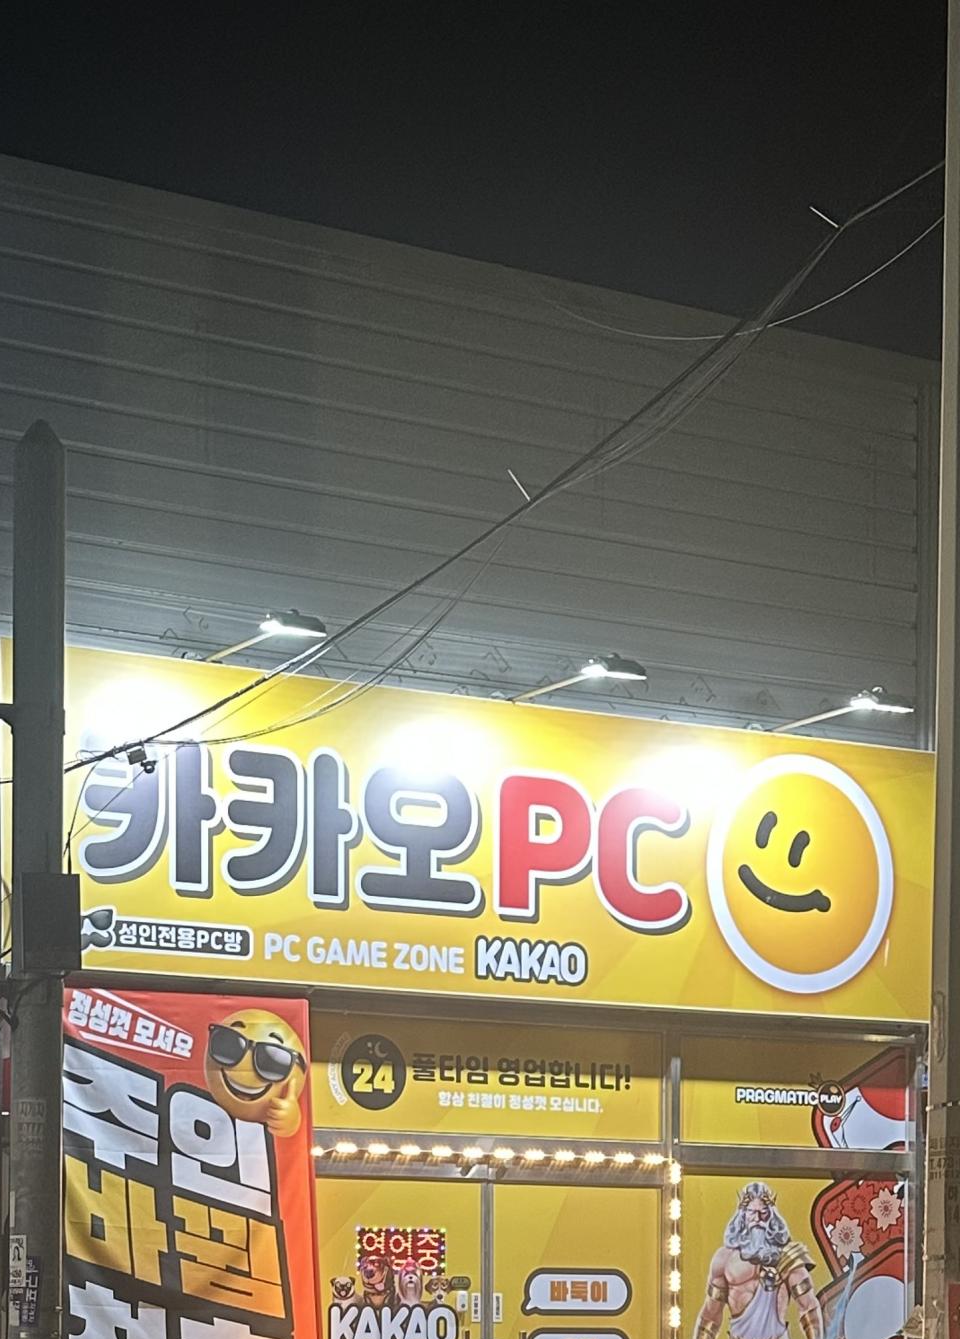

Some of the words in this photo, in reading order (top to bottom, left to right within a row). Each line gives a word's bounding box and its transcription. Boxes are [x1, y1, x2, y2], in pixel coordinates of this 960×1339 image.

[118, 922, 243, 953] 성인전용PC방
[263, 932, 302, 962] PC
[306, 936, 388, 968] GAME
[393, 943, 465, 974] ZONE
[475, 935, 588, 987] KAKAO
[352, 1058, 395, 1094] 24
[412, 1052, 489, 1086] 풀타임
[497, 1056, 632, 1092] 영업합니다!
[736, 1087, 819, 1106] PRAGMATIC
[820, 1094, 842, 1104] PLAY
[62, 1043, 272, 1218] 주인
[550, 1280, 608, 1303] 바둑이
